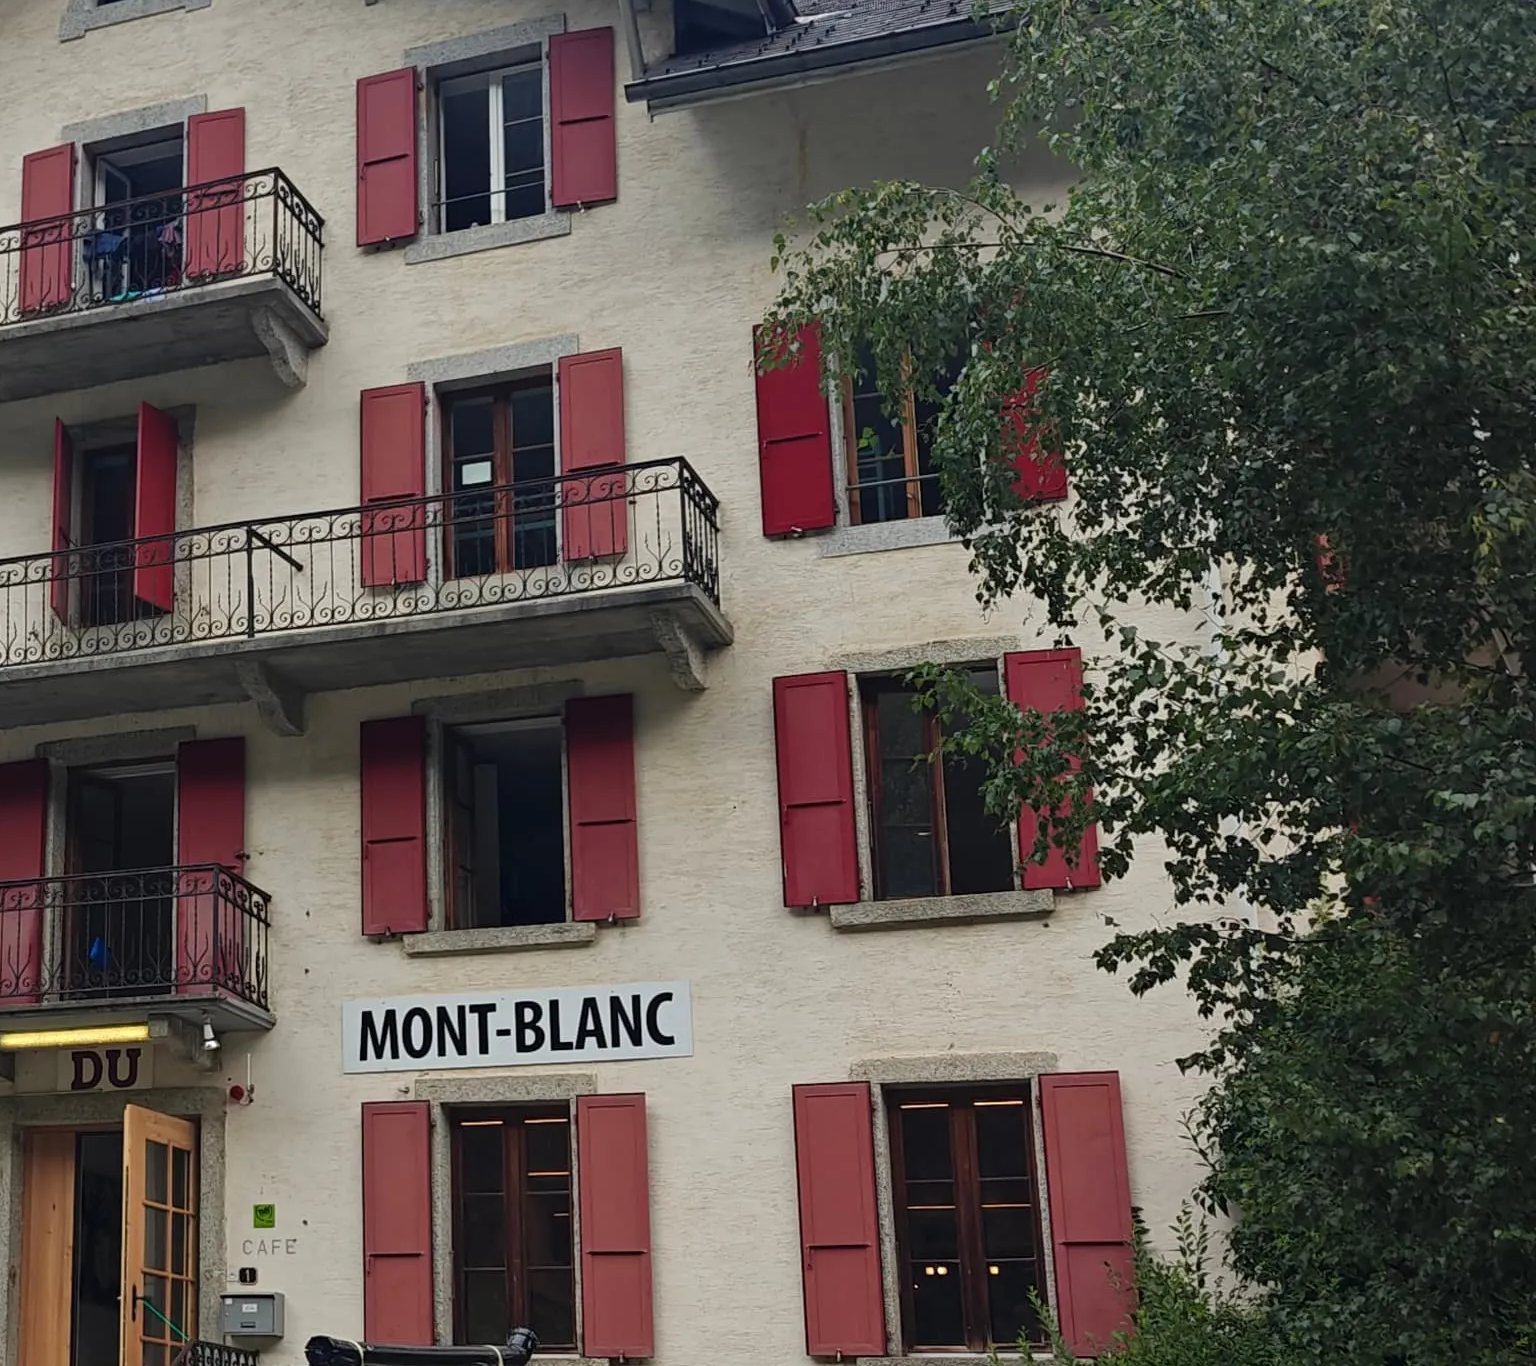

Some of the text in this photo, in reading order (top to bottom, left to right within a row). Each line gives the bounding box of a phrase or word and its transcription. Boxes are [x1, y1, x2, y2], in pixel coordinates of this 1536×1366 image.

[71, 1048, 141, 1090] DU
[359, 991, 676, 1062] MONT-BLANC
[242, 1238, 297, 1255] CAFE
